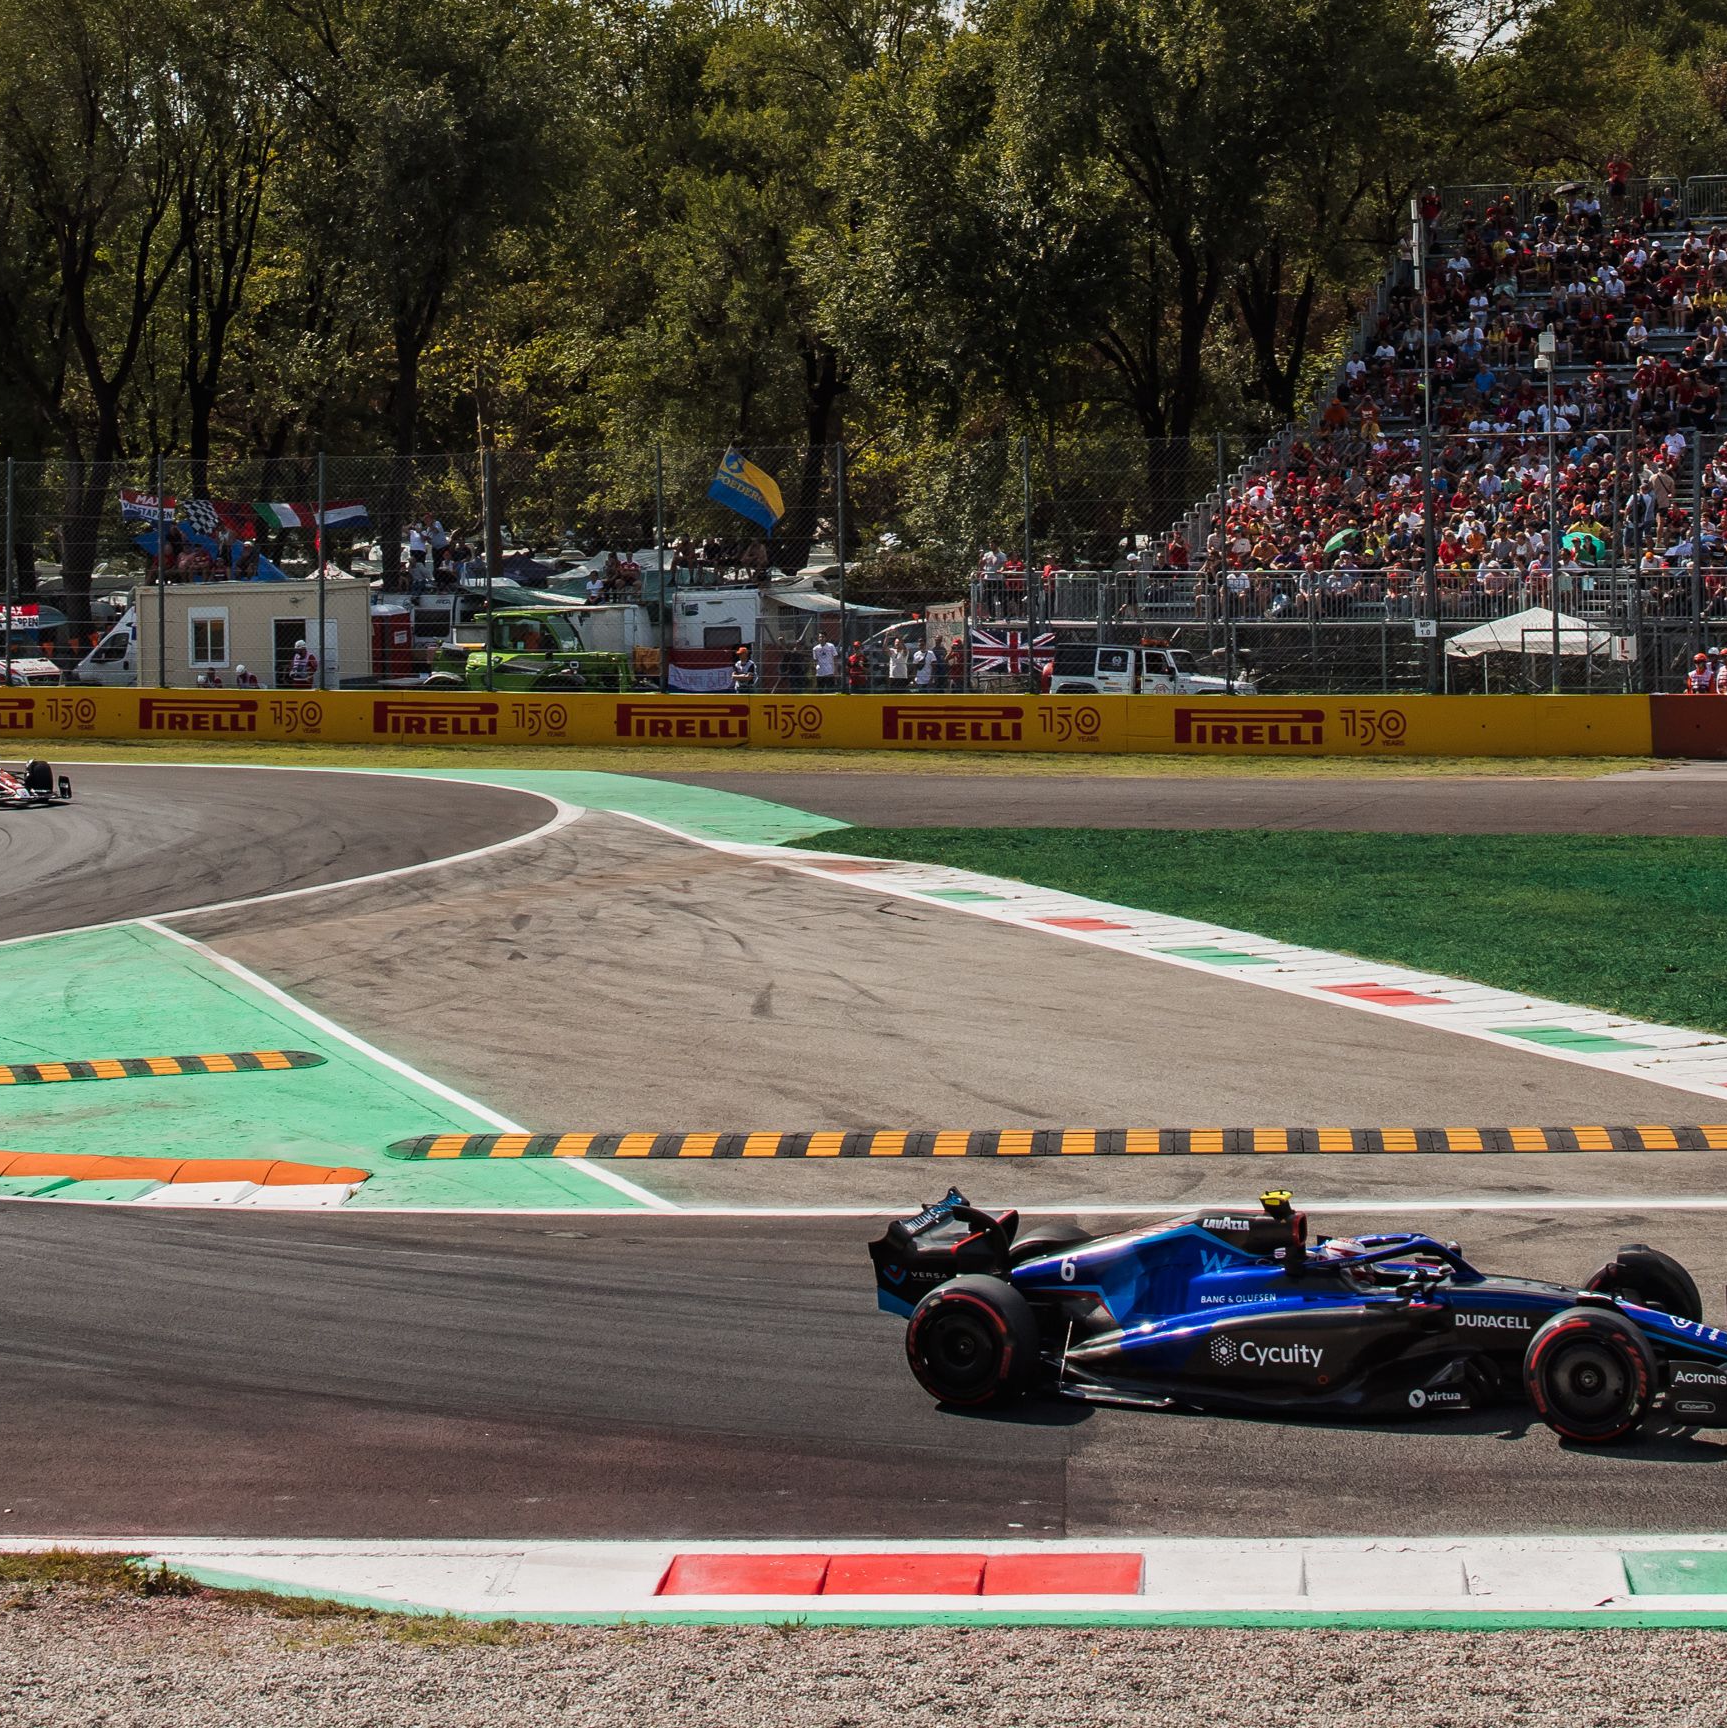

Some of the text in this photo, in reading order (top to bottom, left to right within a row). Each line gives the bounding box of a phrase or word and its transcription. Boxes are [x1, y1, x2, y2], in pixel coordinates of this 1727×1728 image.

[46, 698, 96, 730] 150
[139, 698, 322, 733] PIRELLI 150
[373, 701, 567, 736] PIRELLI 150
[616, 704, 822, 739] PIRELLI 150
[882, 706, 1101, 742] PIRELLI 150
[1174, 709, 1407, 746] PIRELLI 150
[1202, 1217, 1250, 1231] LAVAZZA
[1061, 1256, 1077, 1282] 6
[1201, 1295, 1225, 1303] BANG
[1236, 1293, 1277, 1303] OLUFSEN
[1455, 1314, 1531, 1329] DURACELL
[1240, 1341, 1324, 1367] Cycuity
[1675, 1371, 1727, 1384] Acronis
[1427, 1391, 1461, 1401] virtua
